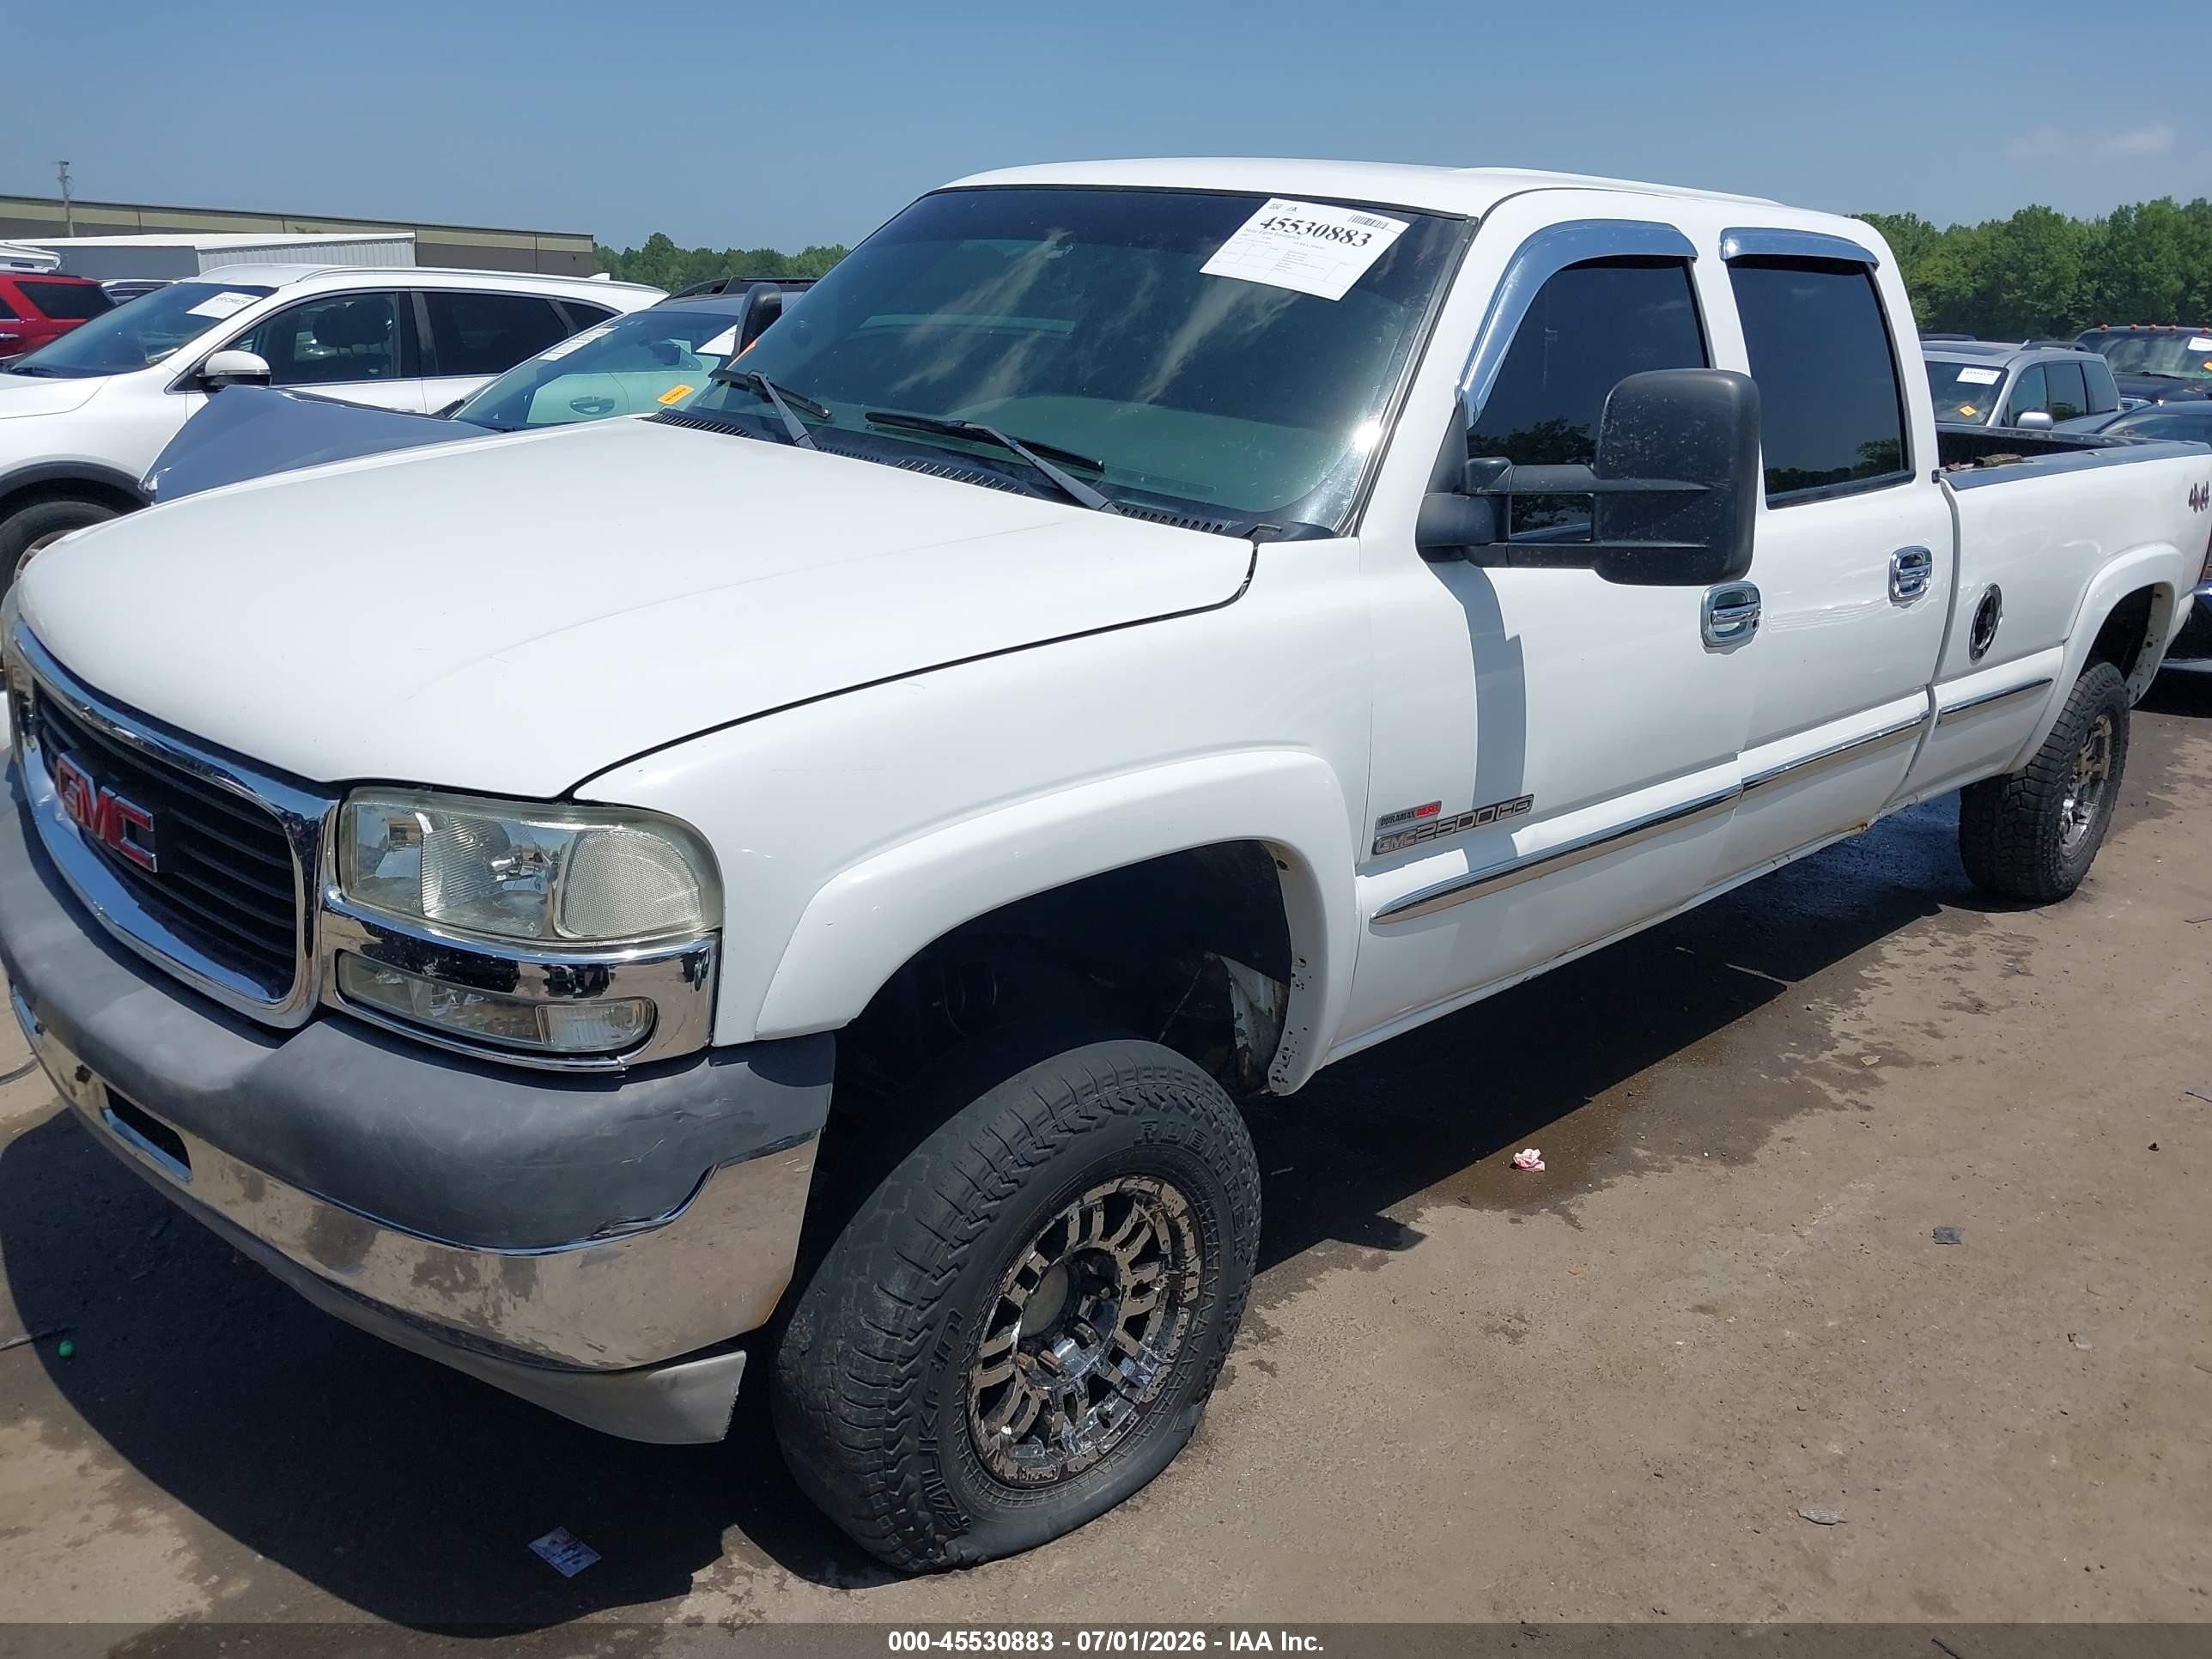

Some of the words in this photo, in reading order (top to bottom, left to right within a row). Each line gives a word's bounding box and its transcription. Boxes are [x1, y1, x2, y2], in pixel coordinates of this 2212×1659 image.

[1260, 216, 1373, 247] 45530883
[57, 752, 158, 872] GMC
[1380, 810, 1416, 826] DURAMAX
[1133, 1118, 1246, 1261] RUBITREK
